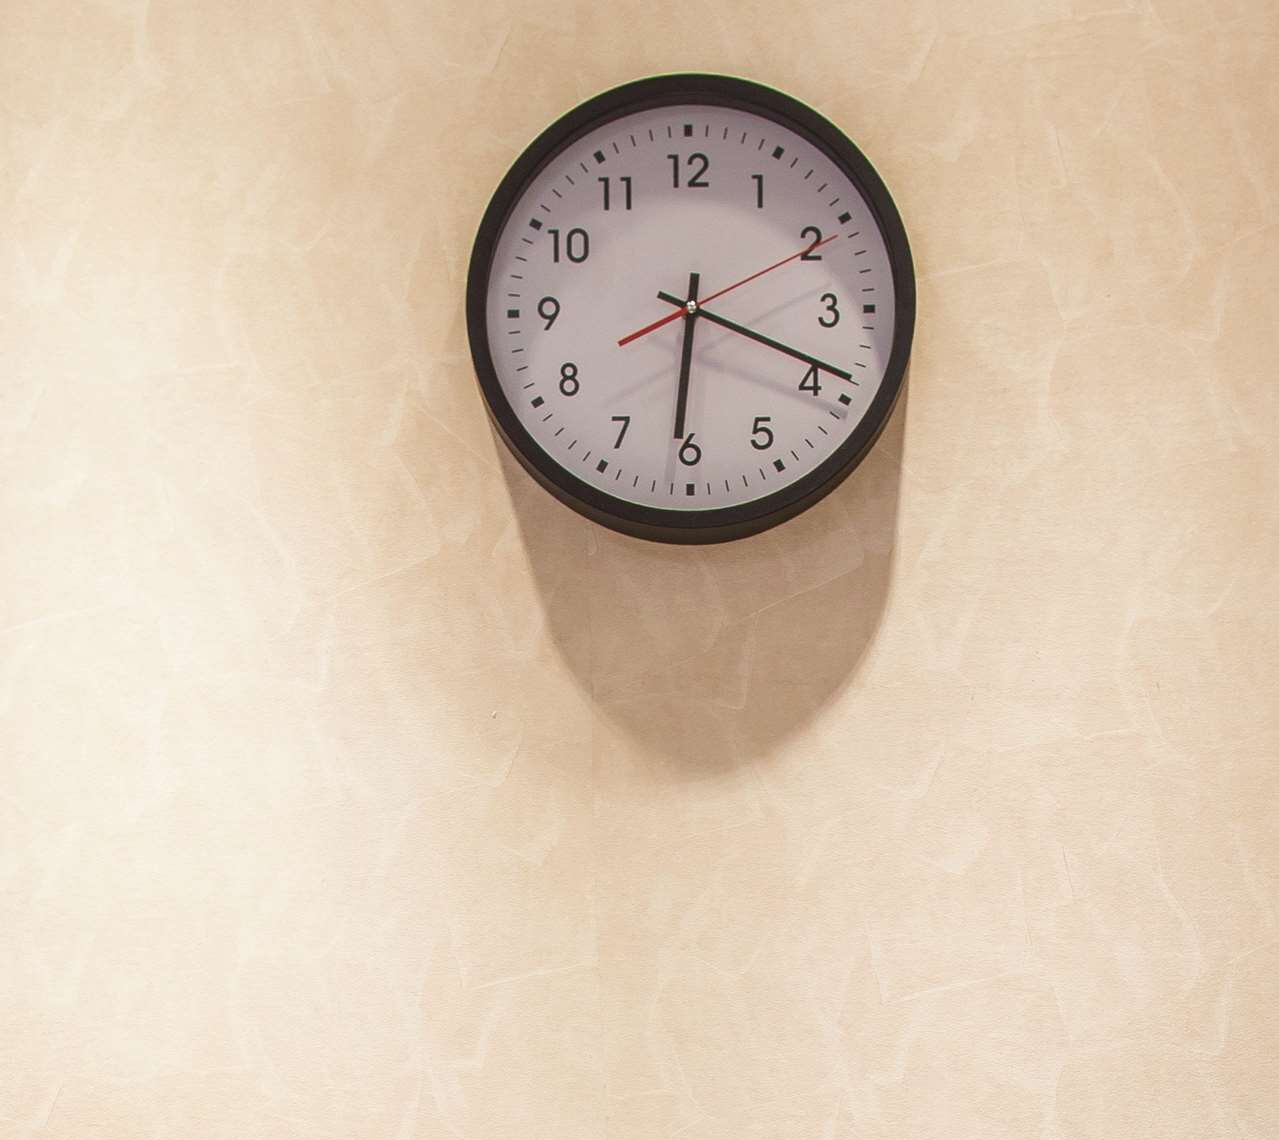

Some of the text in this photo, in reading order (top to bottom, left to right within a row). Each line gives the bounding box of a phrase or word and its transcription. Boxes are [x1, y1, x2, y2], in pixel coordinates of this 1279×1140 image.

[667, 152, 710, 189] 12
[598, 176, 633, 211] 11
[751, 174, 764, 209] 1
[547, 228, 590, 263] 10
[799, 226, 823, 261] 2
[536, 295, 561, 331] 9
[817, 292, 841, 328] 3
[558, 362, 581, 397] 8
[798, 363, 822, 397] 4
[611, 415, 631, 449] 7
[678, 432, 702, 466] 6
[750, 416, 775, 450] 5
